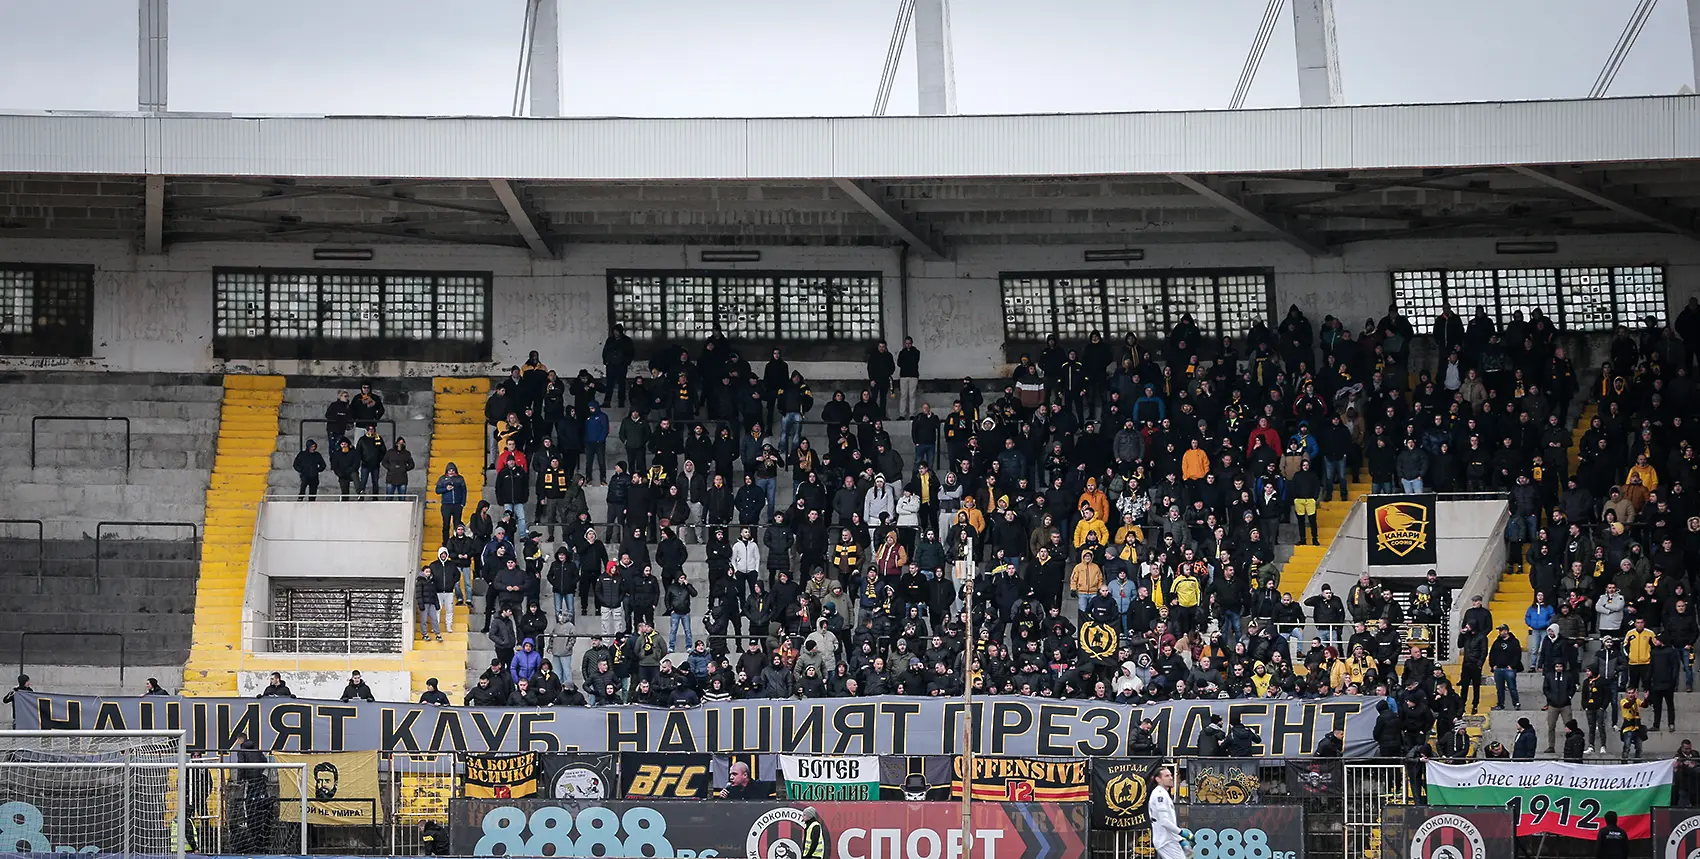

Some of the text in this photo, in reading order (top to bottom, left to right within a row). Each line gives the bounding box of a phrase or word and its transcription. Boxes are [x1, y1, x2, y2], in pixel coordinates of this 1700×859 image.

[1384, 531, 1420, 540] КАНАРИ
[37, 698, 358, 756] НАШИЯТ
[606, 702, 921, 757] НАШИЯТ
[941, 702, 1362, 758] ПРЕЗИДЕНТ
[465, 752, 535, 771] ЗА БОТЕВ
[797, 758, 860, 780] БОТЕВ
[953, 755, 1087, 784] OFFENSIVE
[1107, 763, 1149, 774] БРИГАДА
[467, 764, 535, 783] ВСИЧКО
[627, 764, 706, 797] BFC
[1477, 767, 1513, 786] днес
[1518, 772, 1538, 789] ще
[1544, 770, 1564, 786] ви
[1569, 770, 1655, 790] изпием!!!
[791, 783, 870, 801] ПЛОВДИВ
[1008, 781, 1033, 801] 12
[1226, 789, 1243, 800] 18+
[331, 808, 364, 817] УМИРА!
[756, 811, 806, 829] ЛОКОМОТ
[1104, 812, 1147, 828] ТРАКИЯ
[1505, 794, 1602, 830] 1912
[473, 806, 675, 858] 8888
[1420, 817, 1475, 836] ЛОКОМОТИВ
[837, 827, 1004, 859] СПОРТ
[1182, 827, 1272, 859] 888
